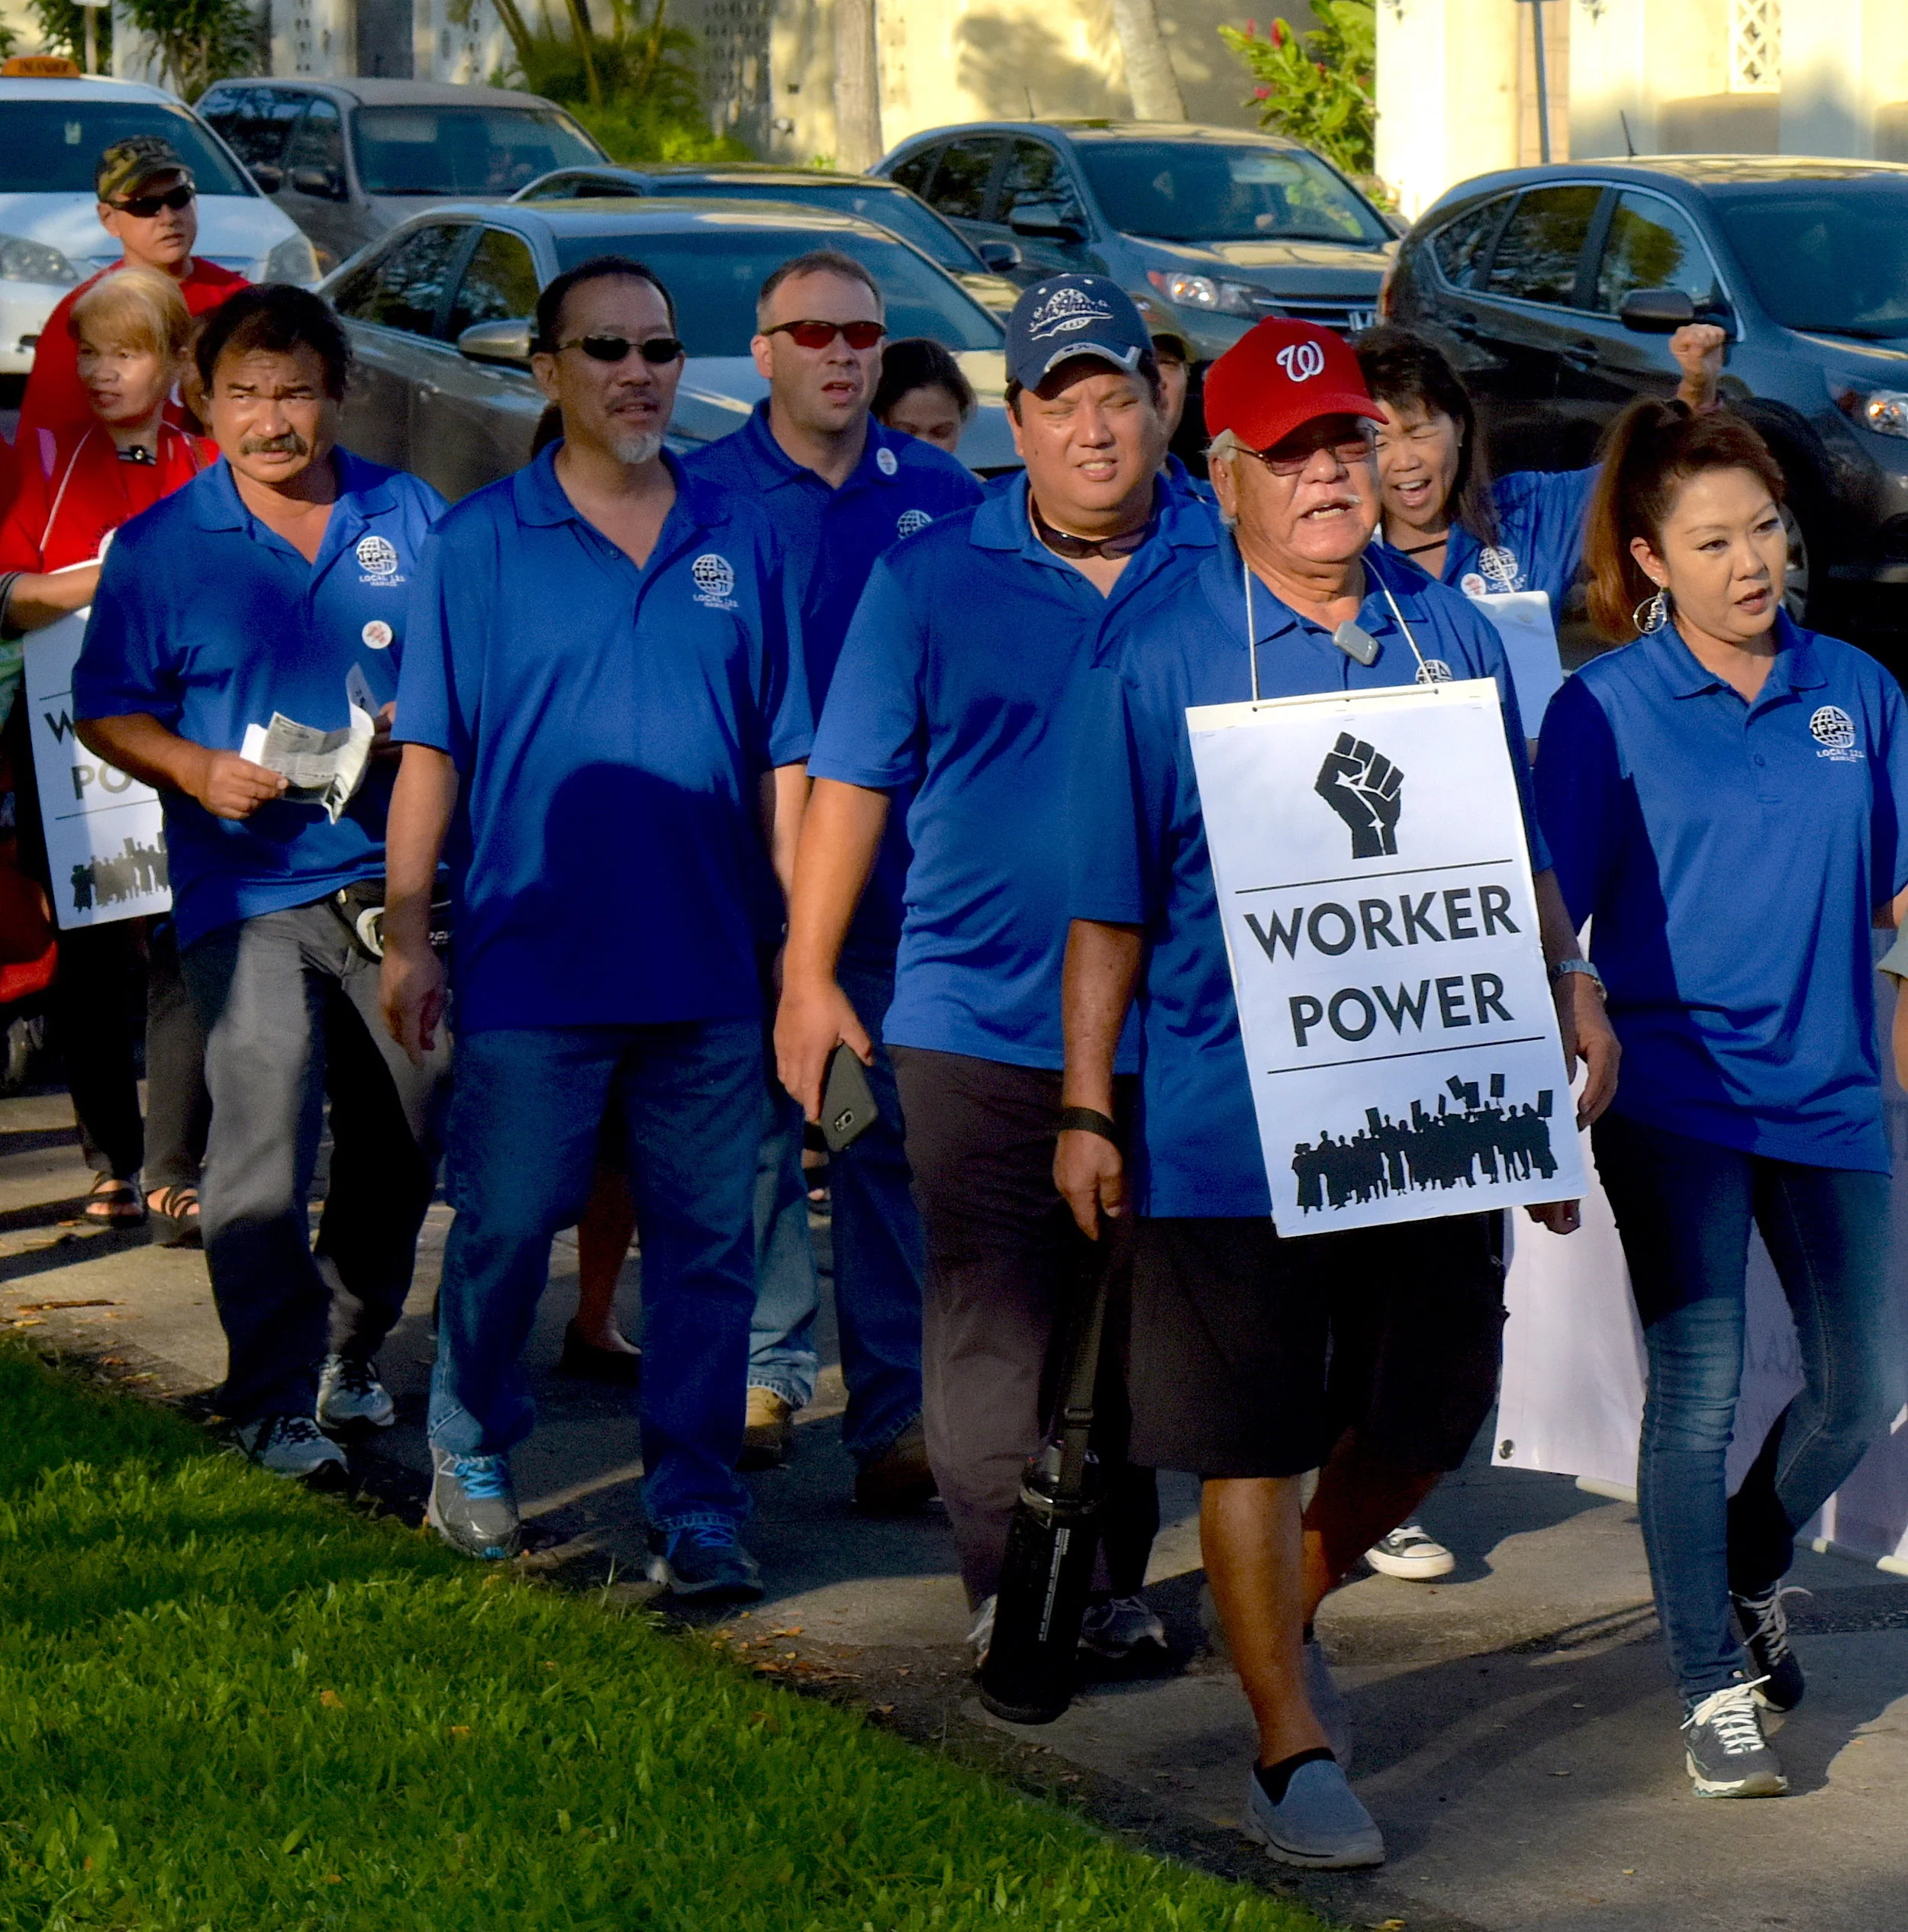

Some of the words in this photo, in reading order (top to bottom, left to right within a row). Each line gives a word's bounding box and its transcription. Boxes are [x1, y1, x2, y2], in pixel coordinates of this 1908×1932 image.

[1276, 341, 1325, 382] W
[1816, 749, 1848, 758] LOCAL
[1242, 884, 1521, 963] WORKER
[1288, 972, 1515, 1048] POWER
